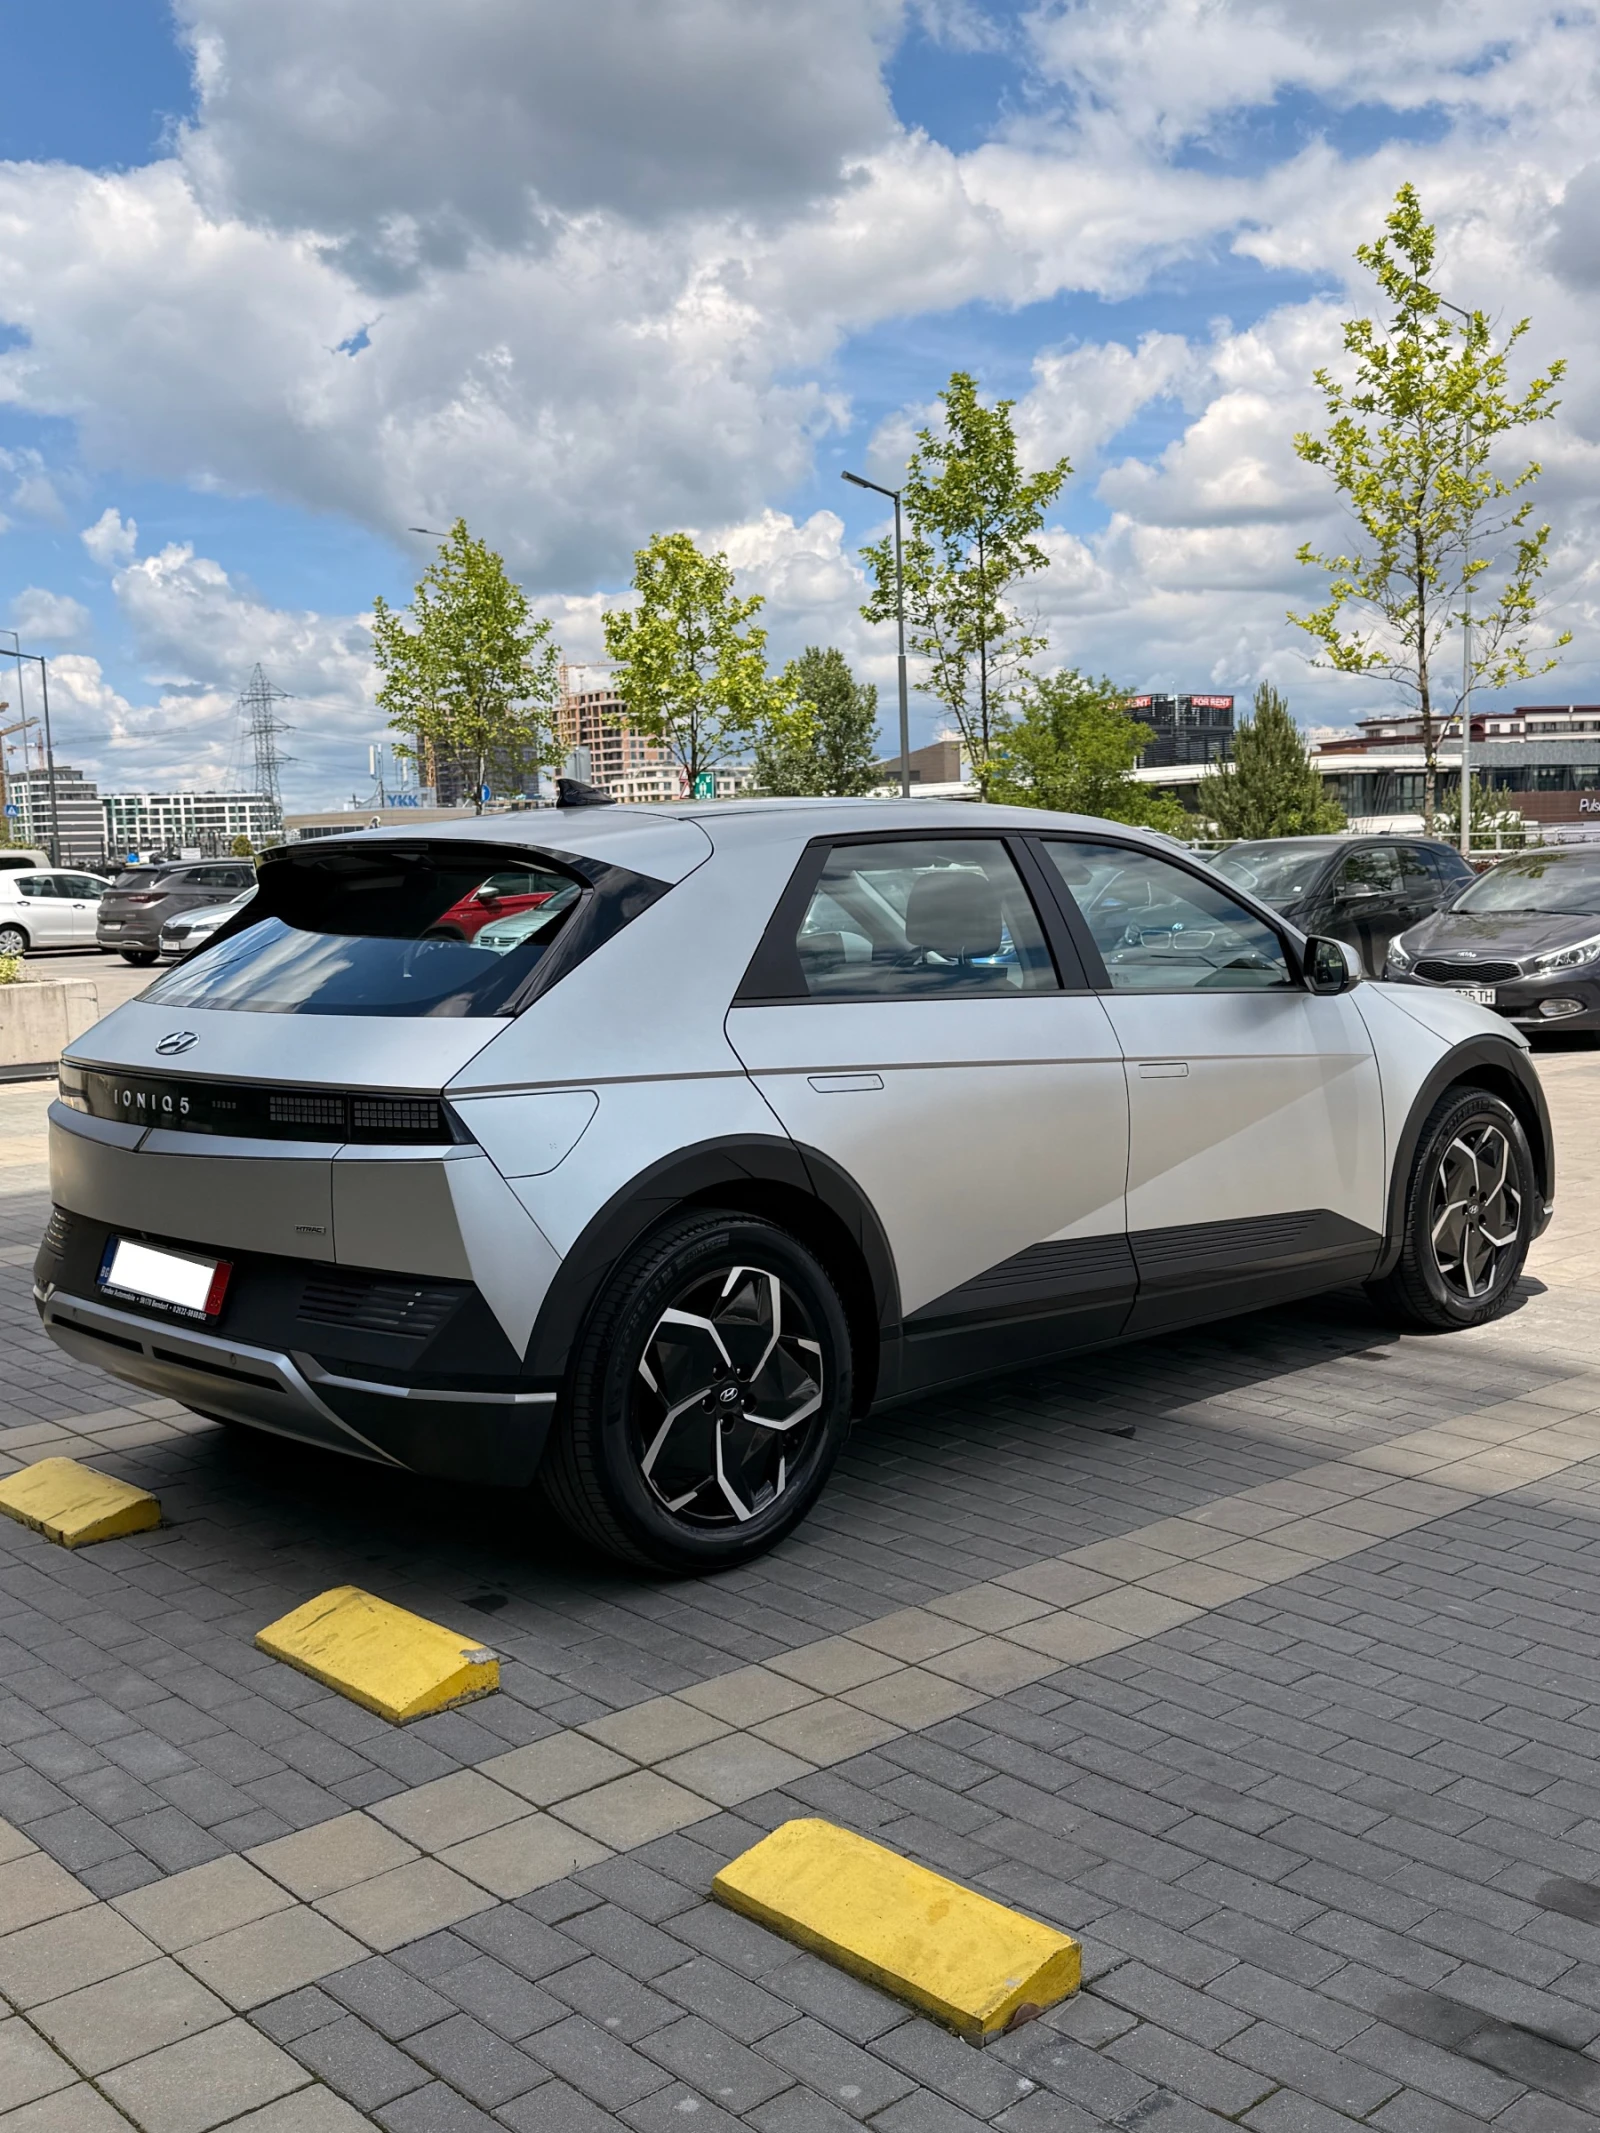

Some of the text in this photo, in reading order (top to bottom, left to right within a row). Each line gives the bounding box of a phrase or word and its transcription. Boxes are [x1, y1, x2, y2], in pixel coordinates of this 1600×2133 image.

[1193, 697, 1230, 708] FOR RENT
[387, 794, 419, 807] YKK
[1478, 990, 1493, 1002] TH
[114, 1089, 190, 1114] IONIQ 5
[100, 1266, 110, 1278] BG
